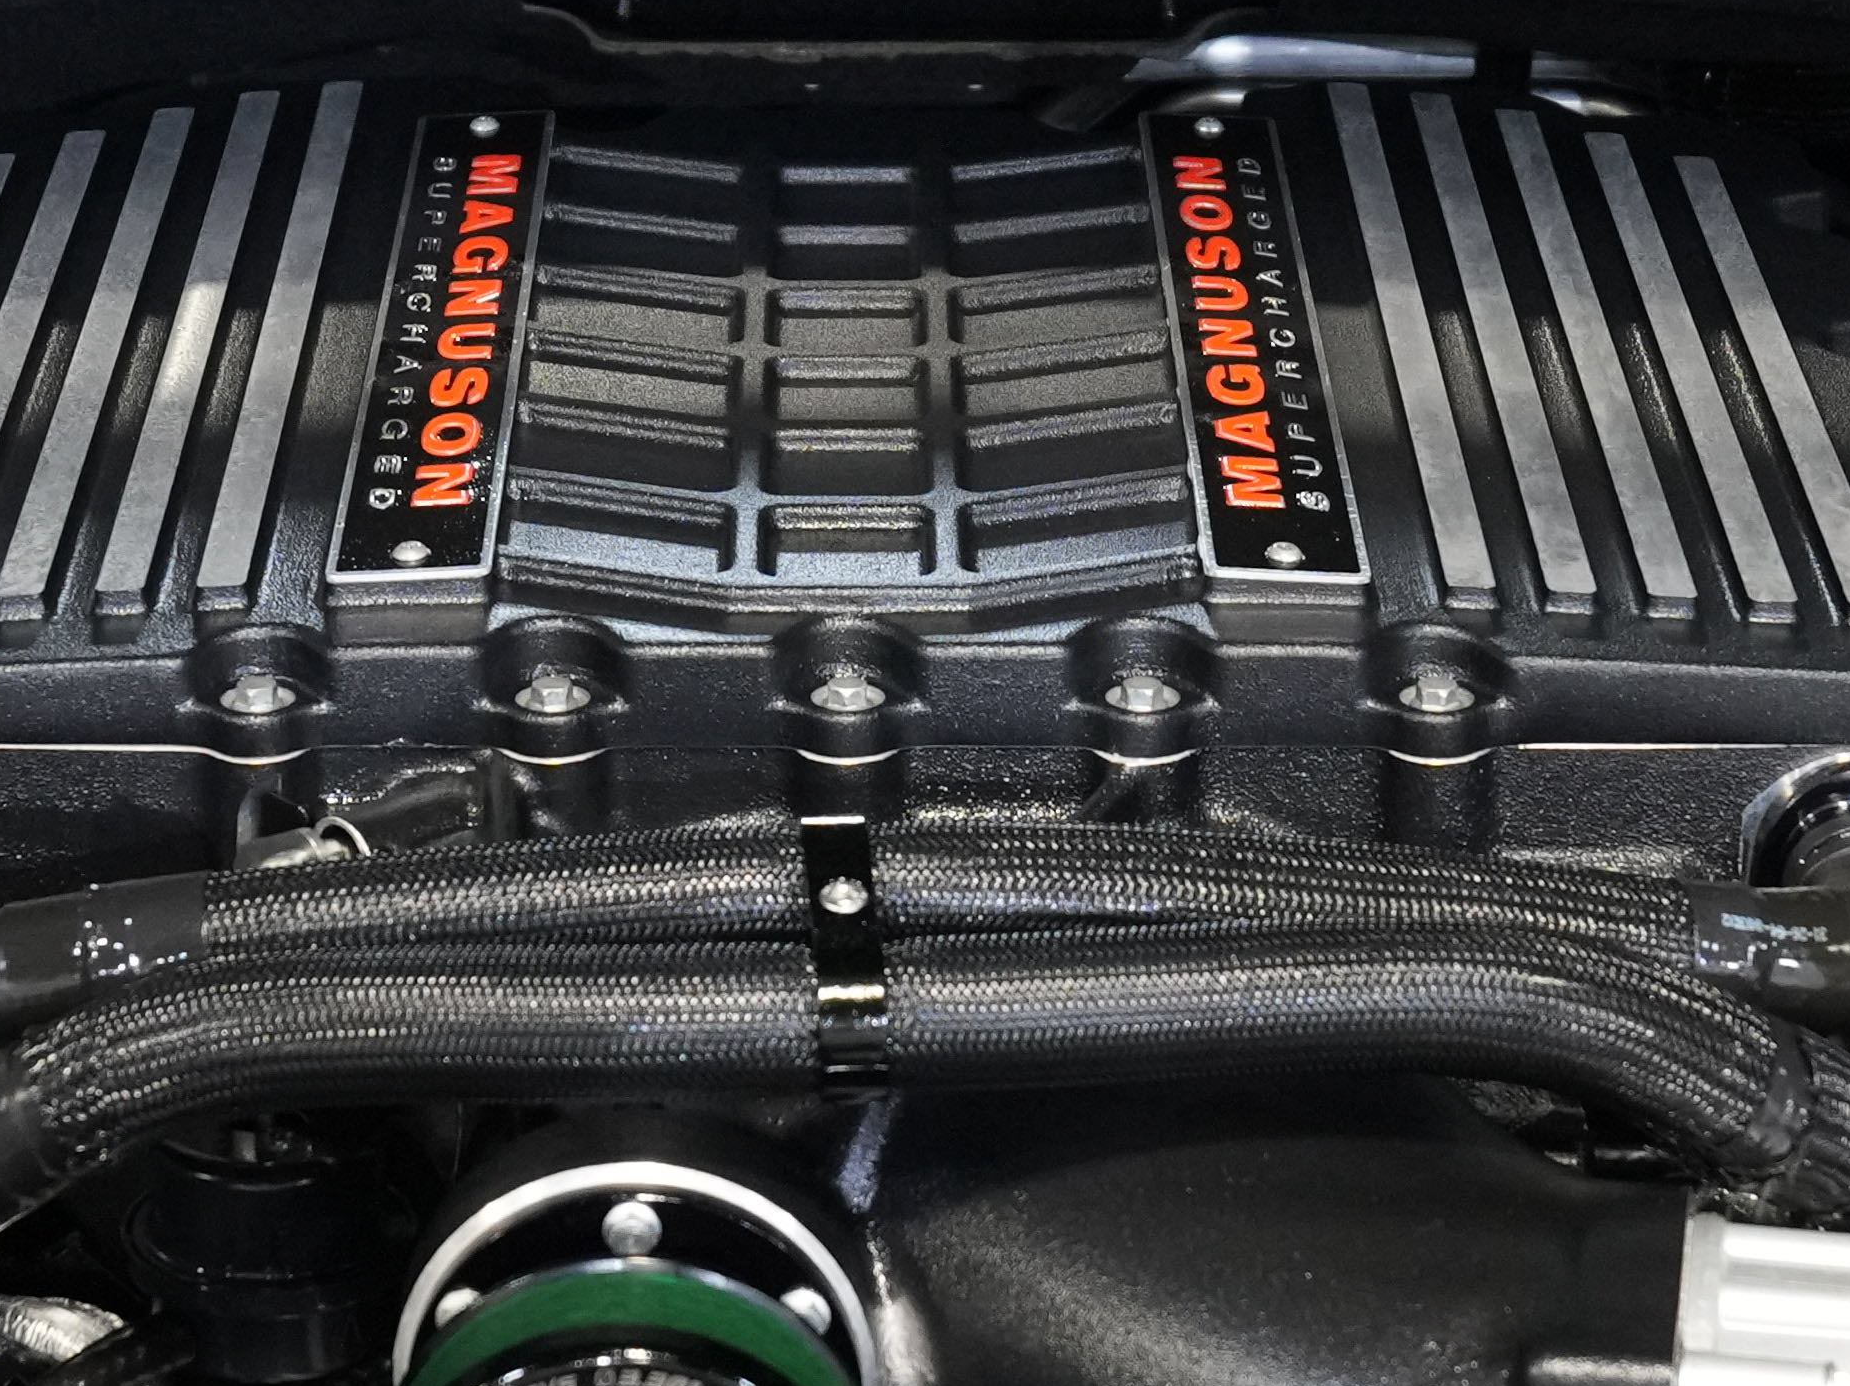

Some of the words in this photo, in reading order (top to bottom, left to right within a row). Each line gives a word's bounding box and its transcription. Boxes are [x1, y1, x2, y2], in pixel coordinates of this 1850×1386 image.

[368, 156, 457, 510] SUPERCHARGED
[410, 154, 521, 508] MAGNUSON
[1173, 155, 1286, 509] MAGNUSON
[1237, 157, 1331, 513] SUPERCHARGED
